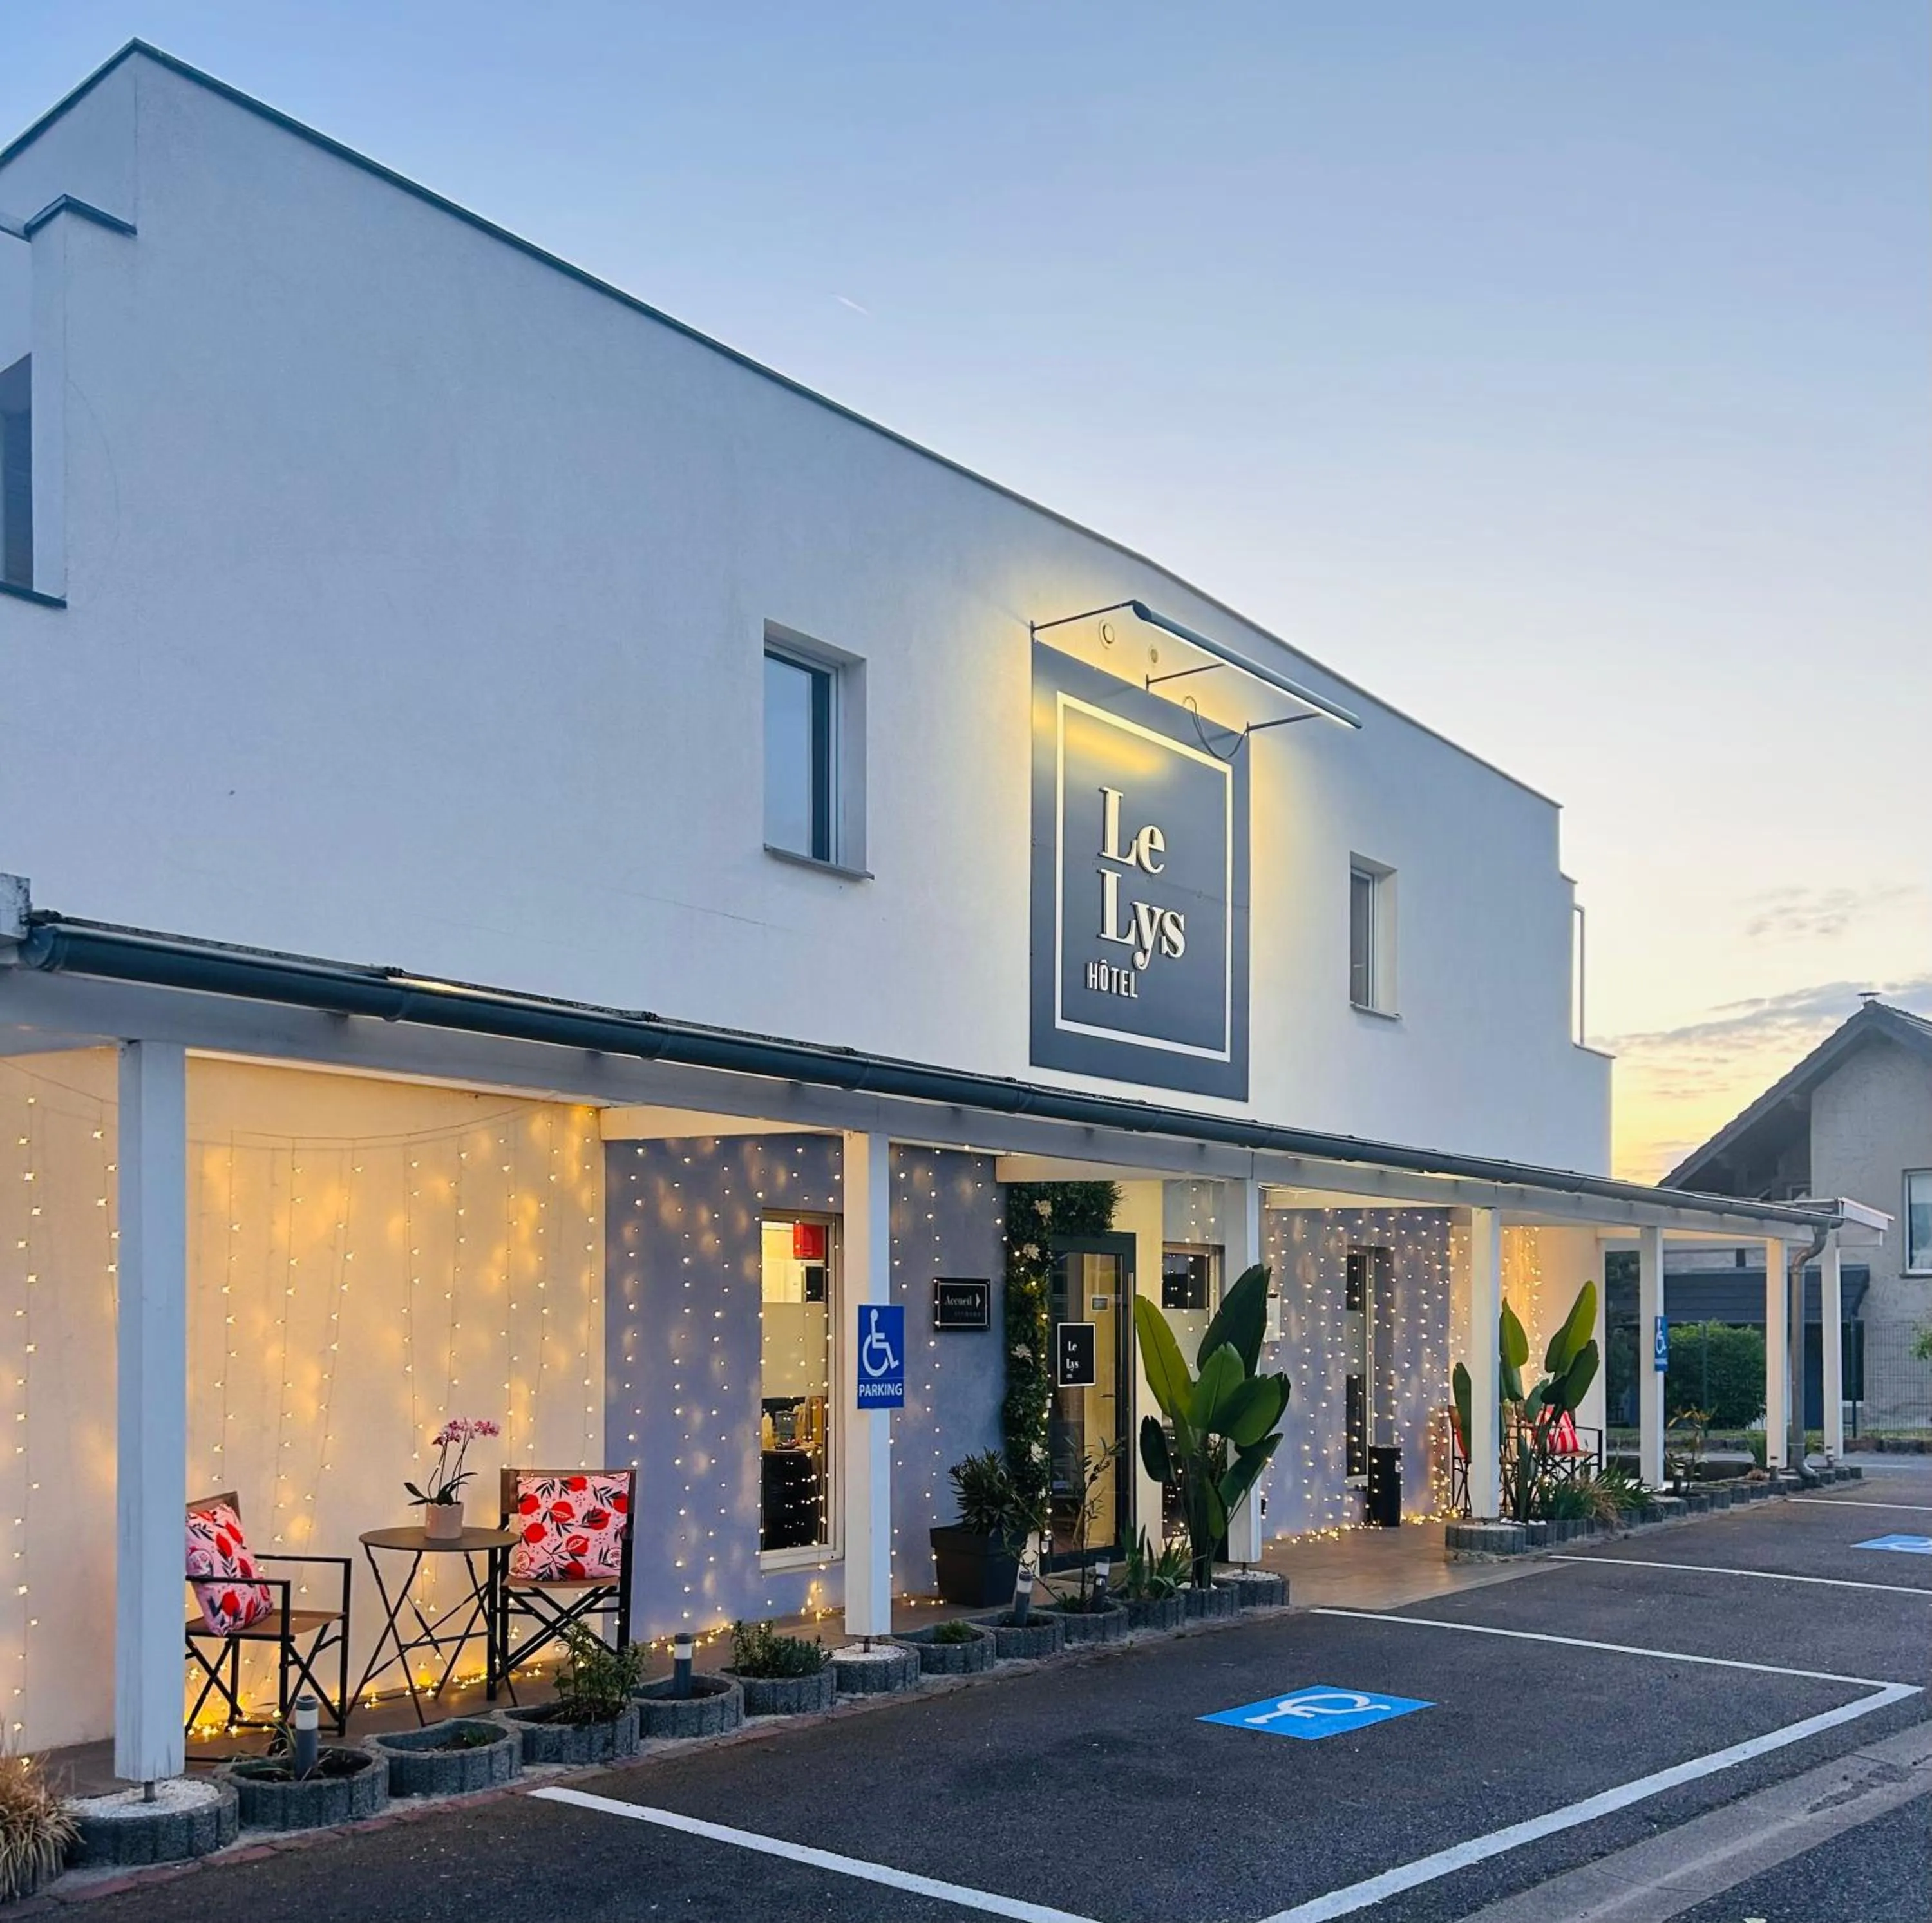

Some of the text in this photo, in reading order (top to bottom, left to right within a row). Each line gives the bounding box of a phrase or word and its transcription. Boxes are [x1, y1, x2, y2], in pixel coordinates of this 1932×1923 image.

[1099, 786, 1165, 874] Le
[1098, 868, 1186, 970] Lys
[1086, 959, 1138, 998] HÔTEL
[858, 1383, 902, 1397] PARKING
